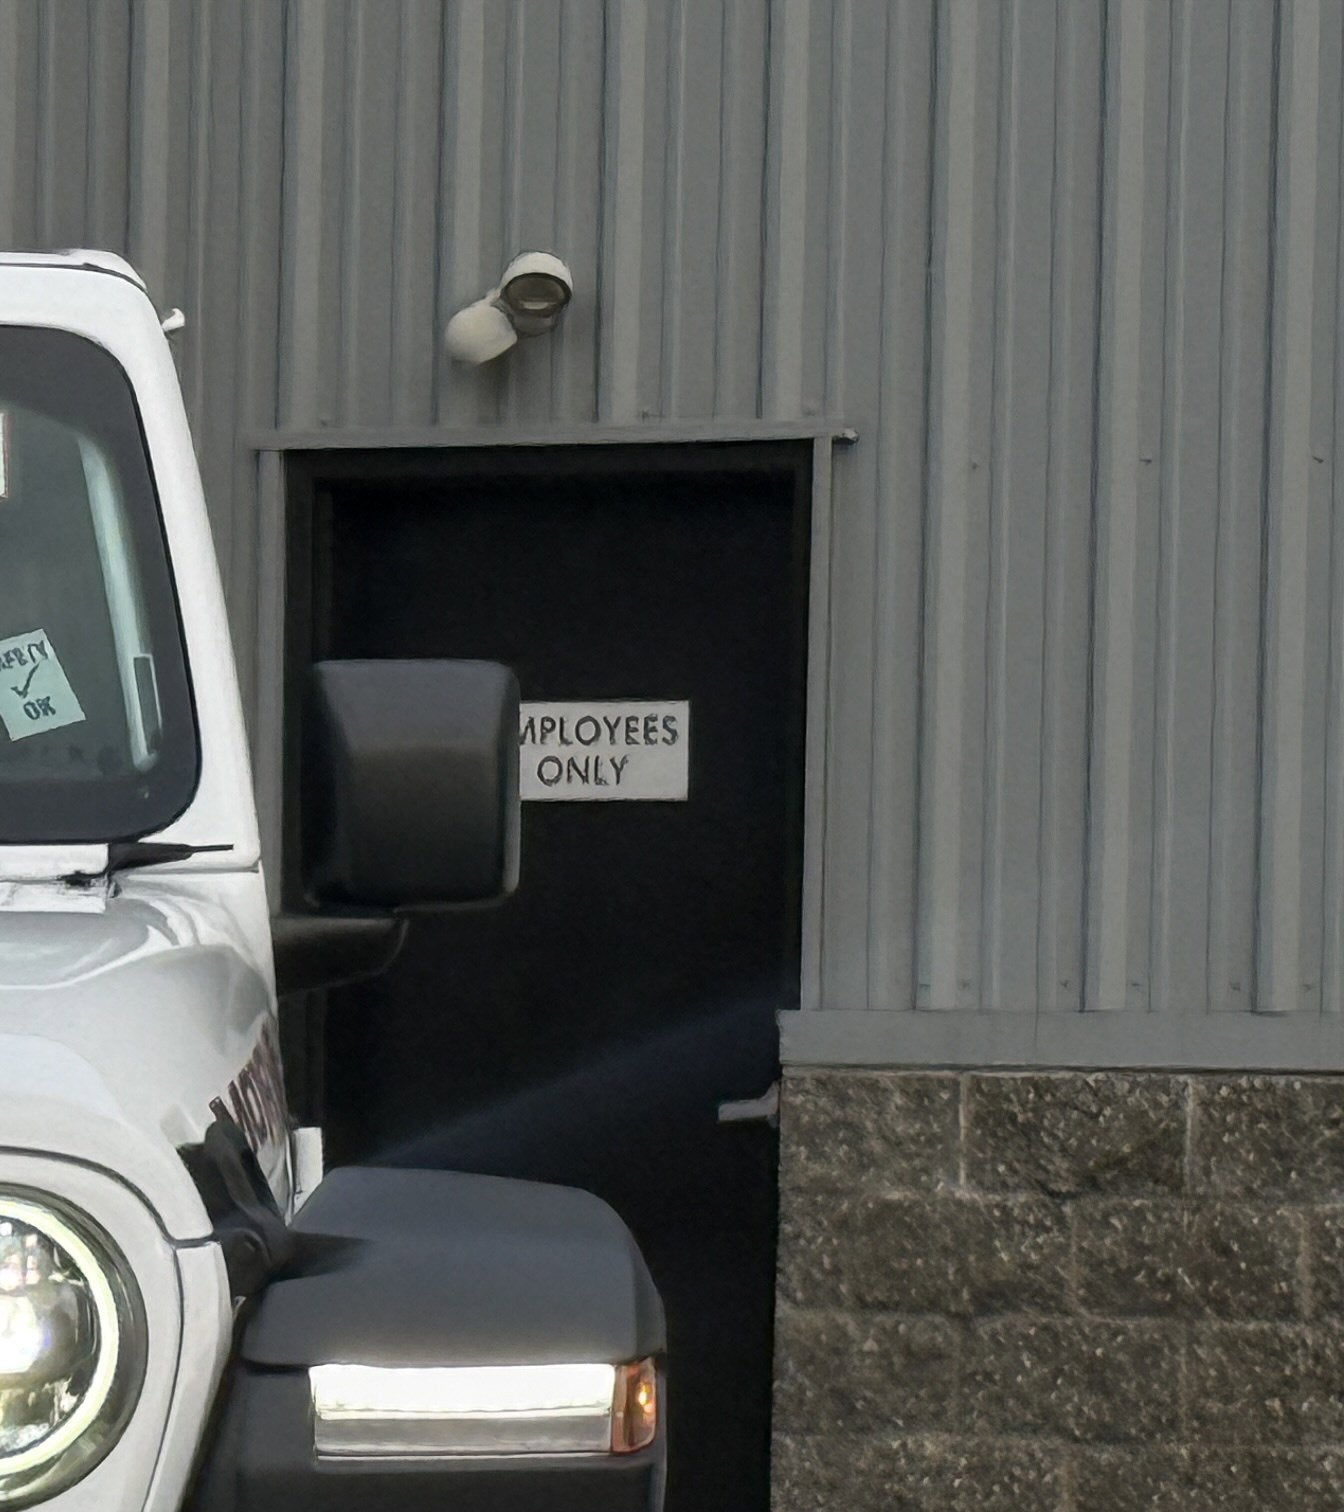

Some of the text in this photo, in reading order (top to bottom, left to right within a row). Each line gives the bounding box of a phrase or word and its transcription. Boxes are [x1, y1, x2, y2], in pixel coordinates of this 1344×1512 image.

[23, 696, 56, 720] OK
[519, 715, 678, 746] MPLOYEES
[537, 755, 628, 786] ONLY
